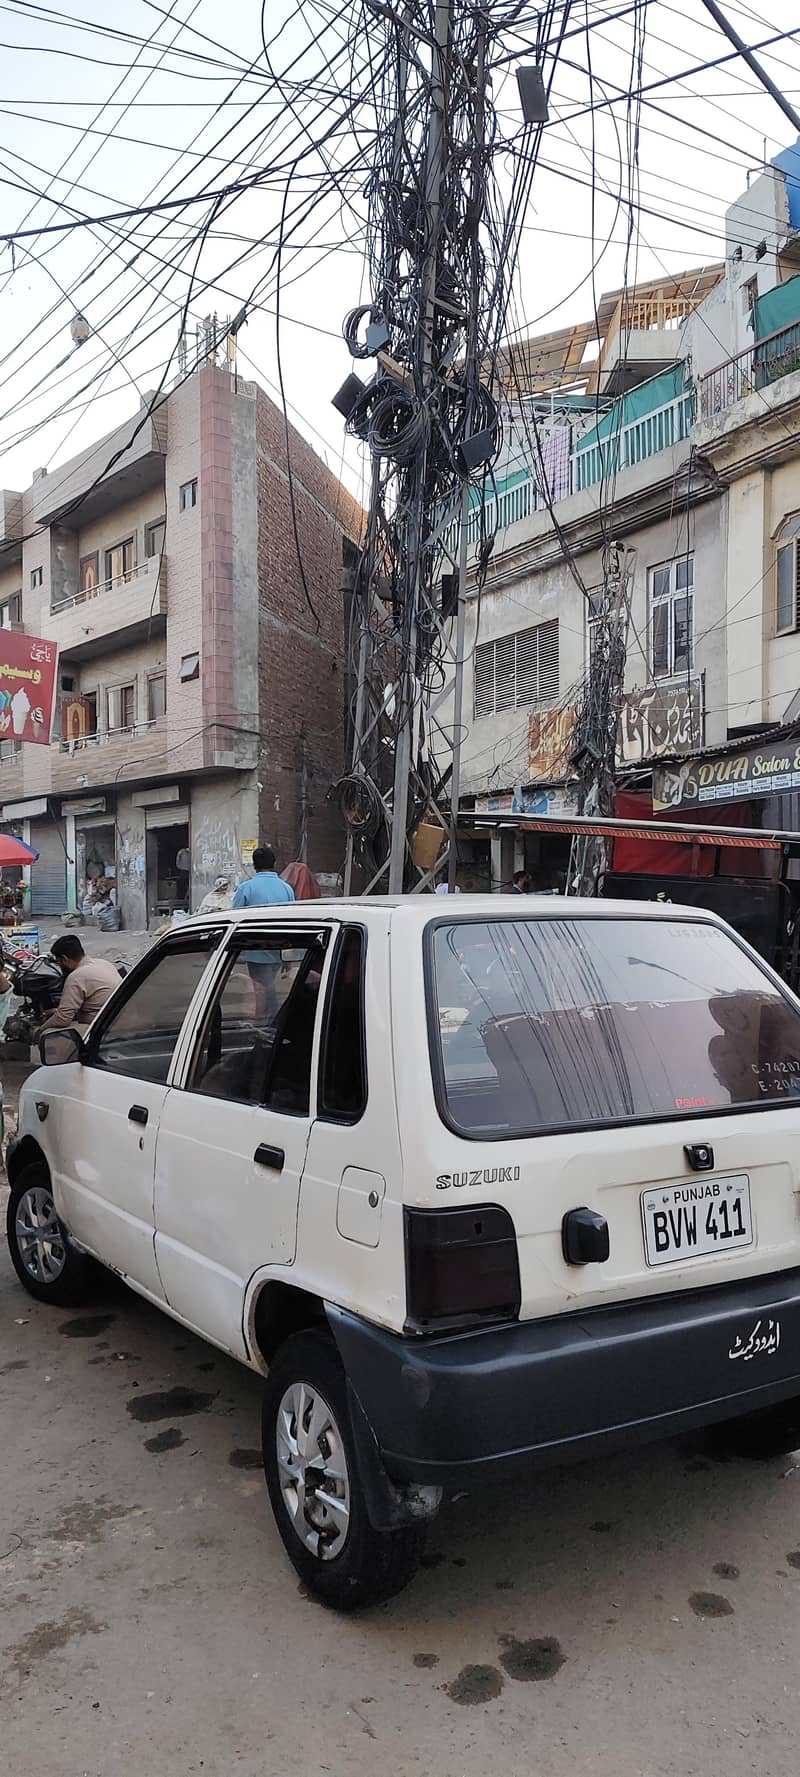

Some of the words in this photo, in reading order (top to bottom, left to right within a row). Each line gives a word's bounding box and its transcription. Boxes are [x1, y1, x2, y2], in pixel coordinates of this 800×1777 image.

[698, 757, 748, 786] DUA
[752, 755, 790, 777] Salon
[435, 1165, 520, 1190] SUZUKI
[673, 1184, 721, 1204] PUNJAB
[653, 1205, 697, 1252] BVW
[705, 1197, 746, 1240] 411
[728, 1319, 780, 1361] ایڈووکیٹ
